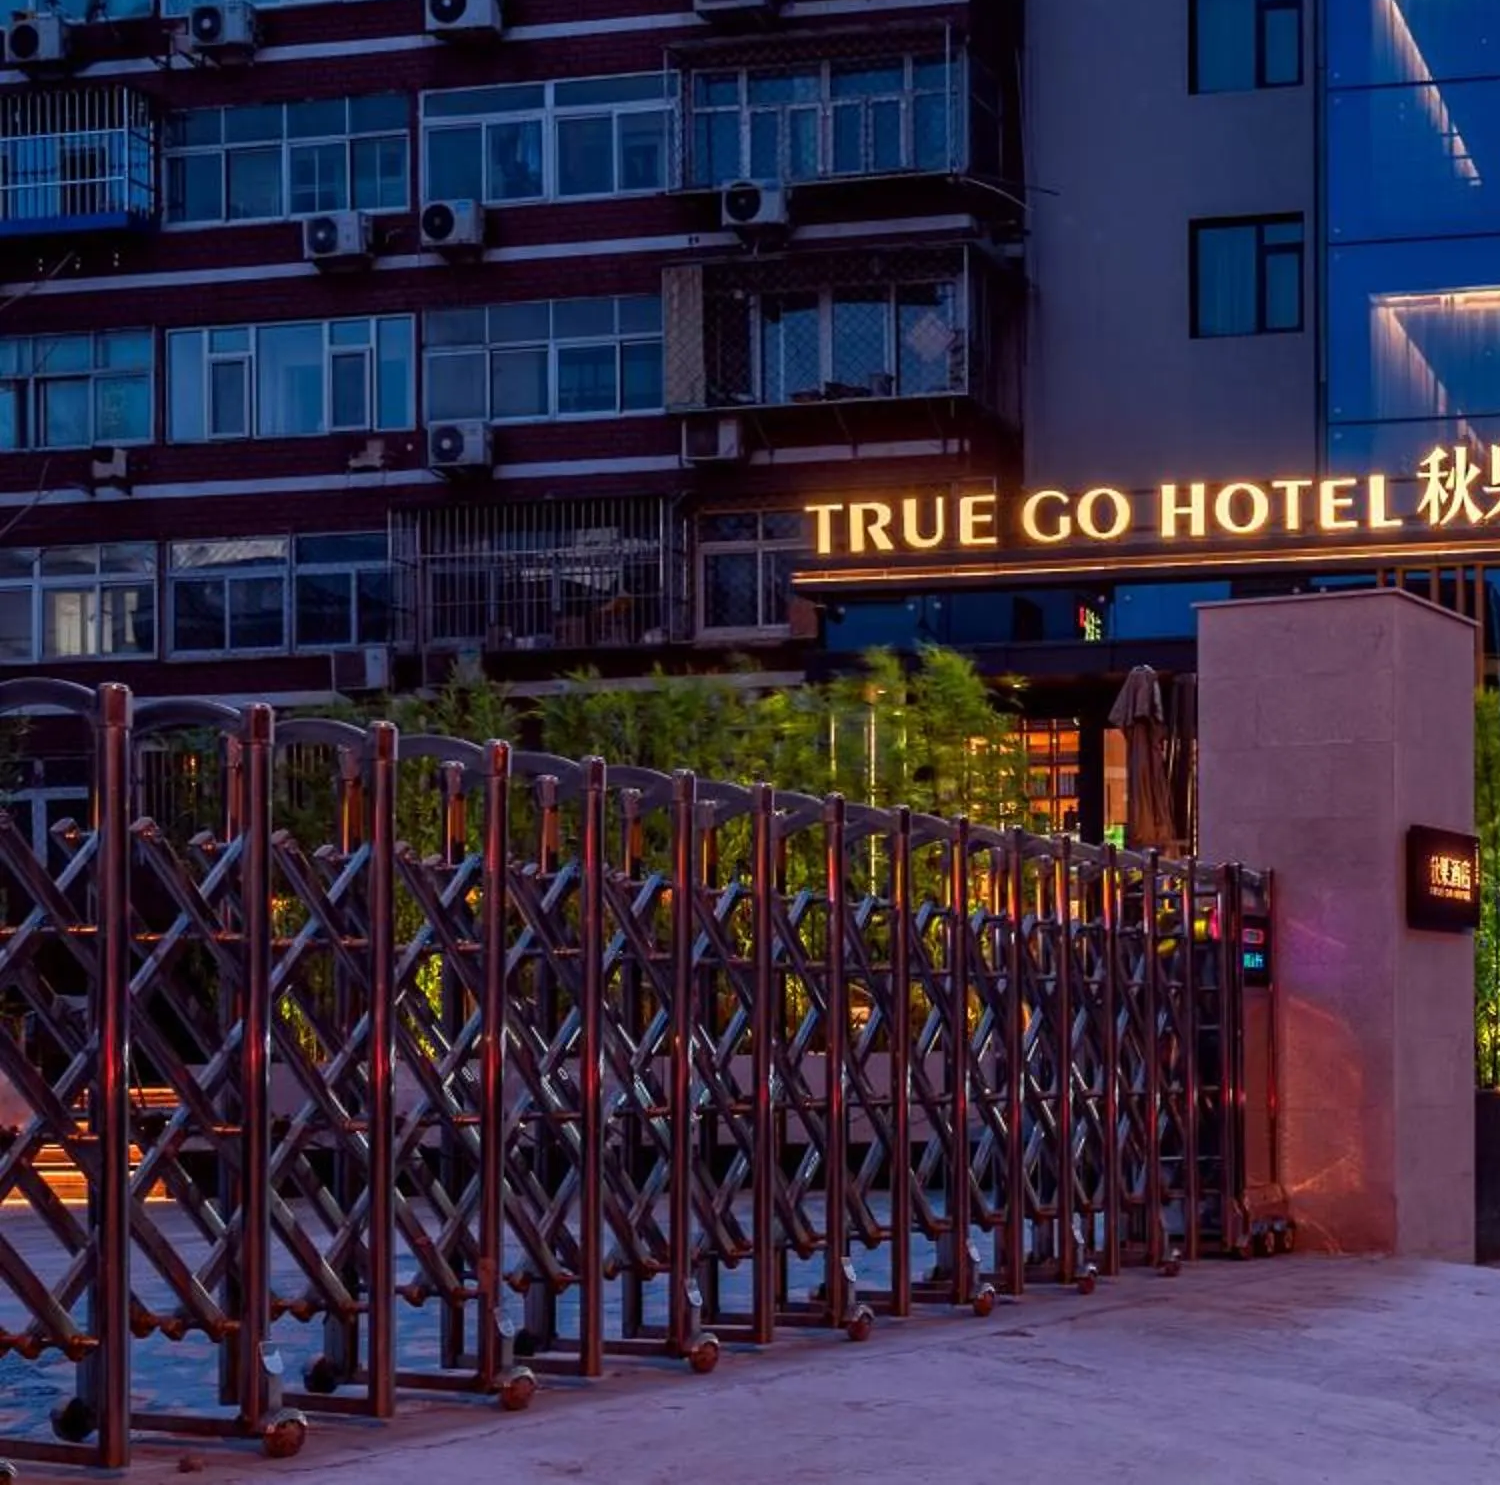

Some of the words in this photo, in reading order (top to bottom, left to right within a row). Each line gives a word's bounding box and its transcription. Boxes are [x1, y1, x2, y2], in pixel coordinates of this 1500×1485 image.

[804, 495, 998, 554] TRUE
[1022, 487, 1131, 542] GO
[1160, 474, 1404, 538] HOTEL
